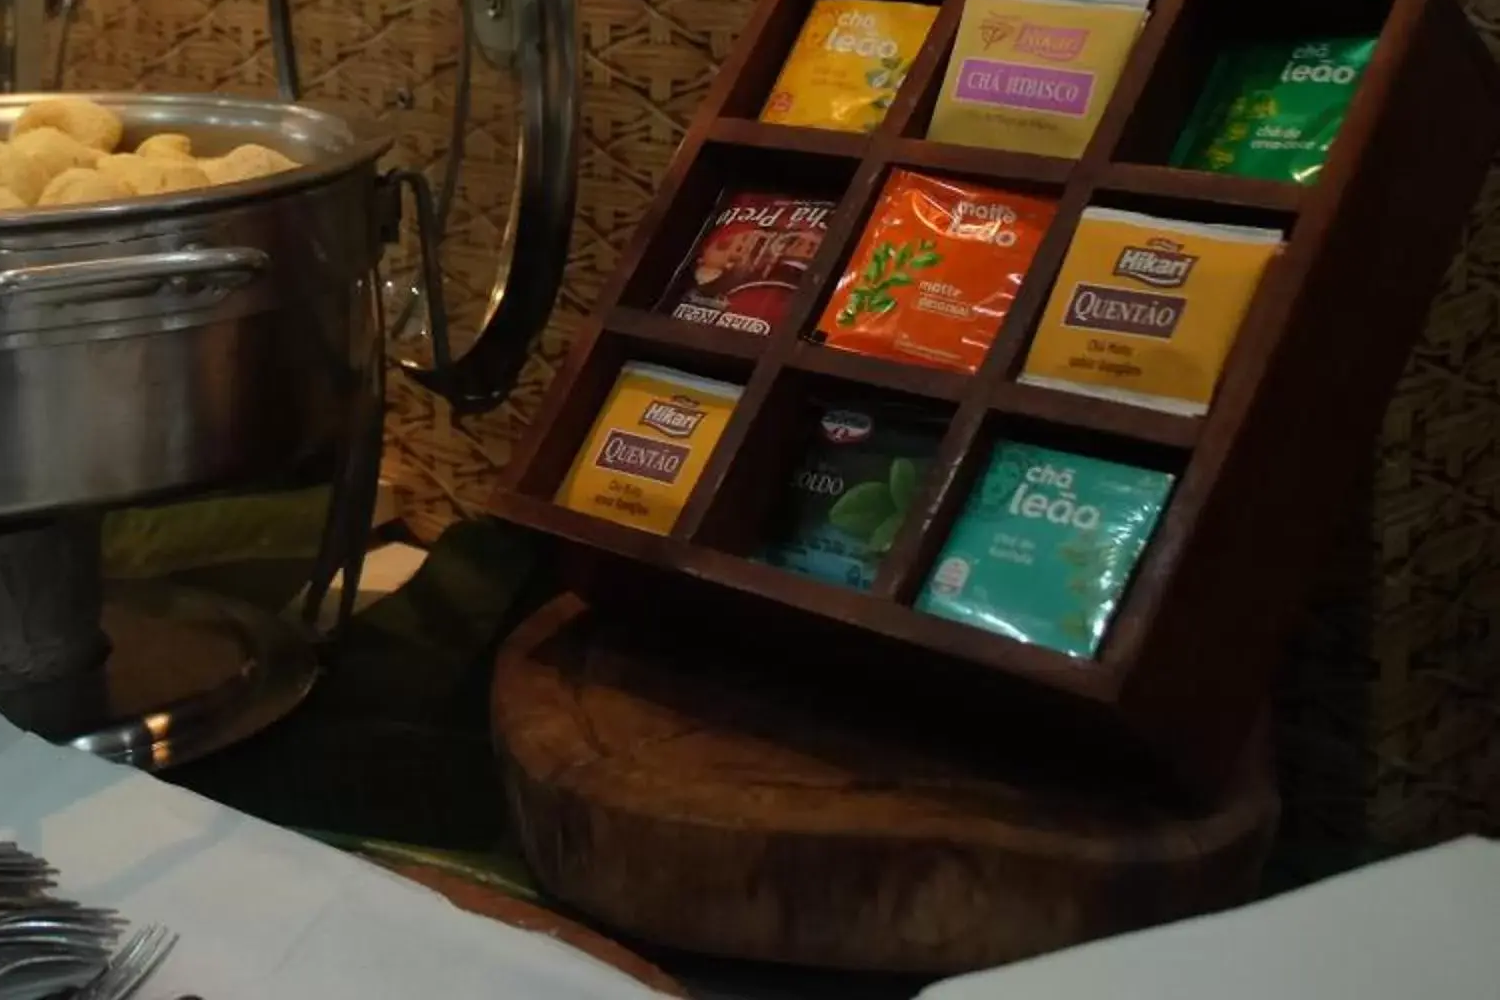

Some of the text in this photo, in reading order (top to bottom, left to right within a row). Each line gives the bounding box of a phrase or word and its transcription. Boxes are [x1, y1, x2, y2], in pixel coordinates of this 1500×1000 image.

[825, 28, 898, 58] leão
[967, 69, 1000, 91] CHÁ
[1279, 58, 1356, 84] leão
[1119, 249, 1192, 277] Hikari
[1074, 290, 1175, 328] QUENTÃO
[644, 402, 702, 429] Hikari
[605, 437, 679, 473] QUENTÃO
[1025, 463, 1077, 488] chá
[1008, 483, 1101, 530] leão
